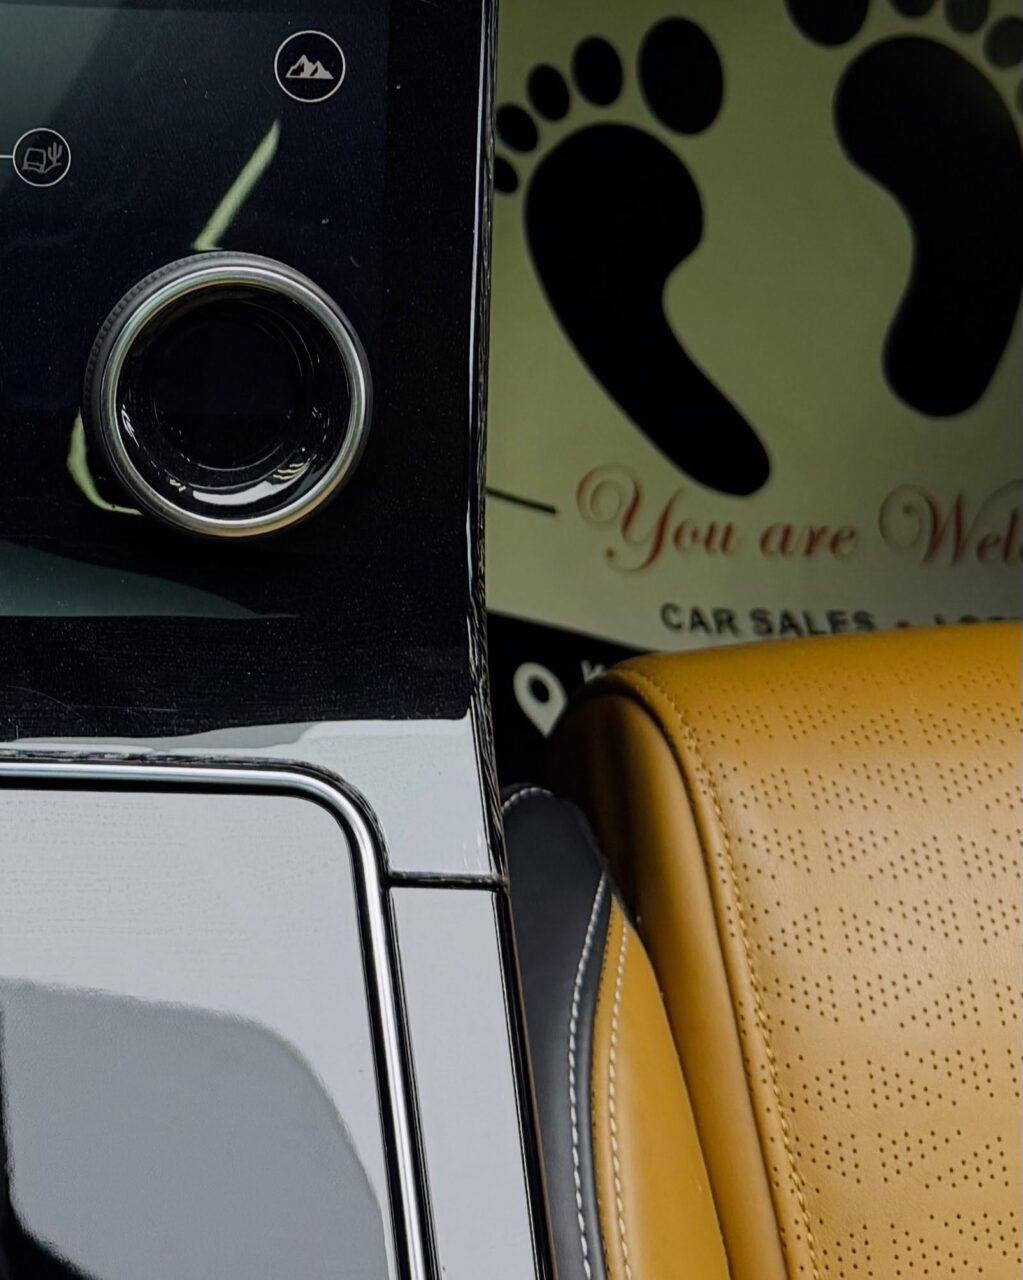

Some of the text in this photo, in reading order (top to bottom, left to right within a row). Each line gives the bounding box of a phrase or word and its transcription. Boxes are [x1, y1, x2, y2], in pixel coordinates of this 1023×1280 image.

[576, 464, 1023, 572] You are Wel
[660, 603, 739, 635] CAR
